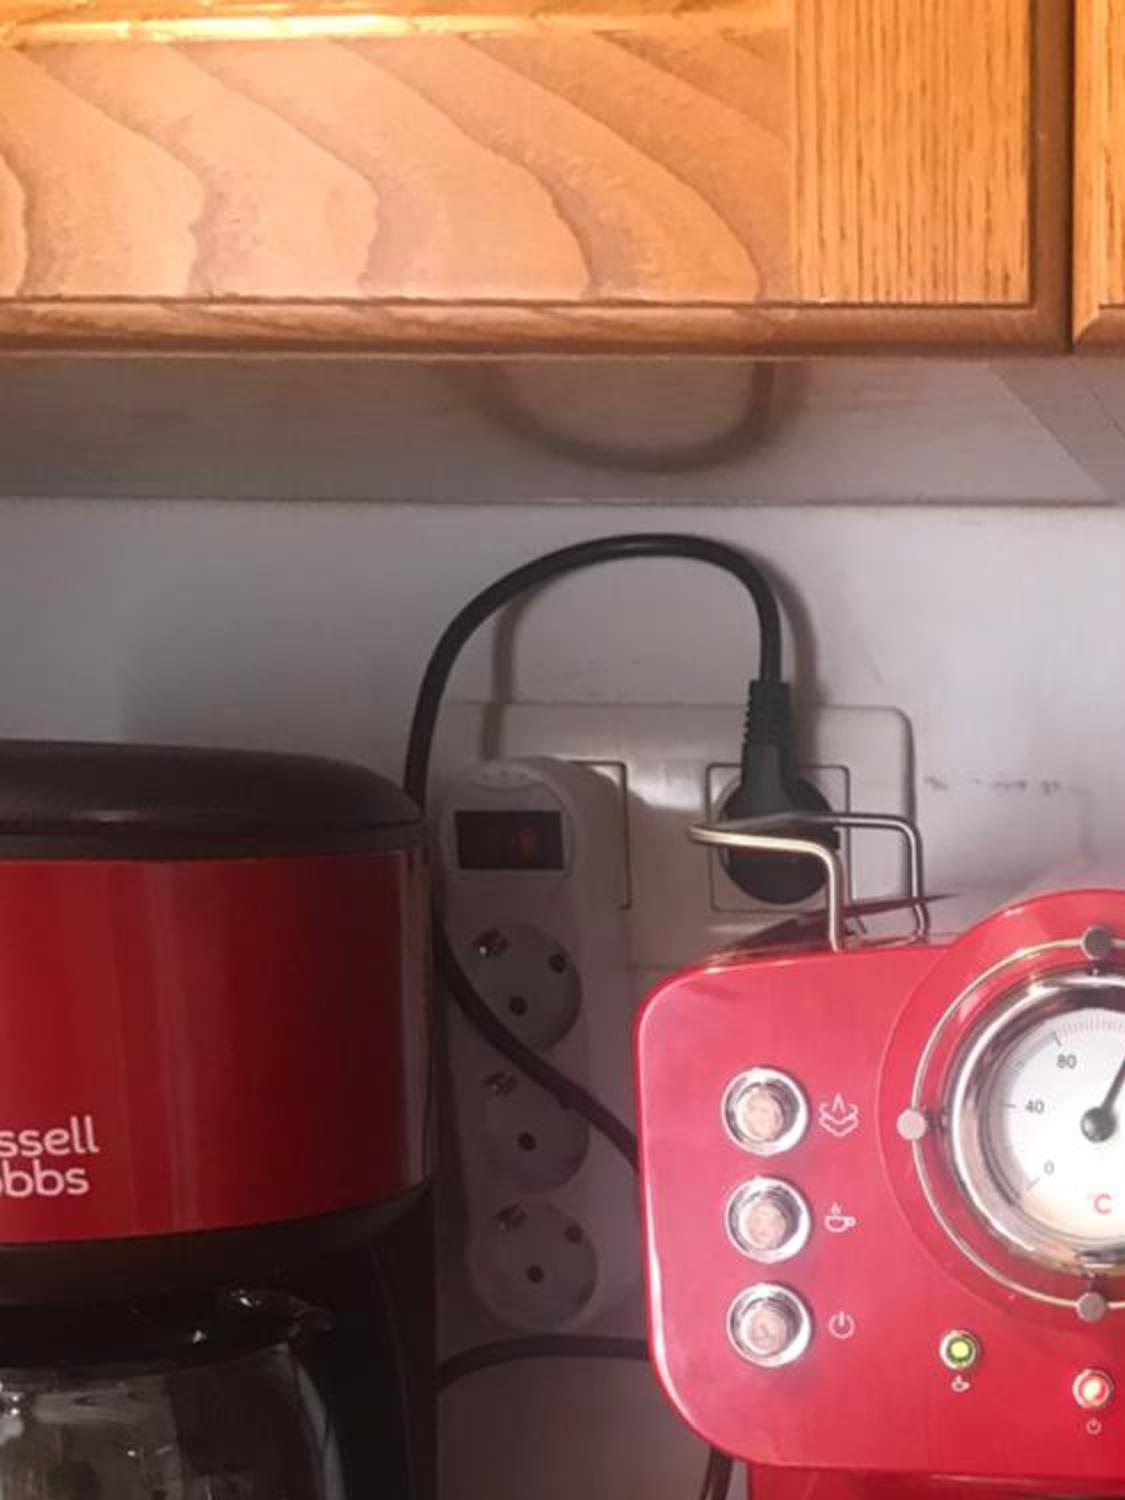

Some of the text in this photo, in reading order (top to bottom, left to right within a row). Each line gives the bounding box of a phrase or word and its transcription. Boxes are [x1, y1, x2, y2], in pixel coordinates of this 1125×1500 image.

[1056, 1054, 1078, 1070] 80
[1024, 1099, 1045, 1115] 40
[1043, 1159, 1055, 1176] 0
[0, 1158, 90, 1199] bbs
